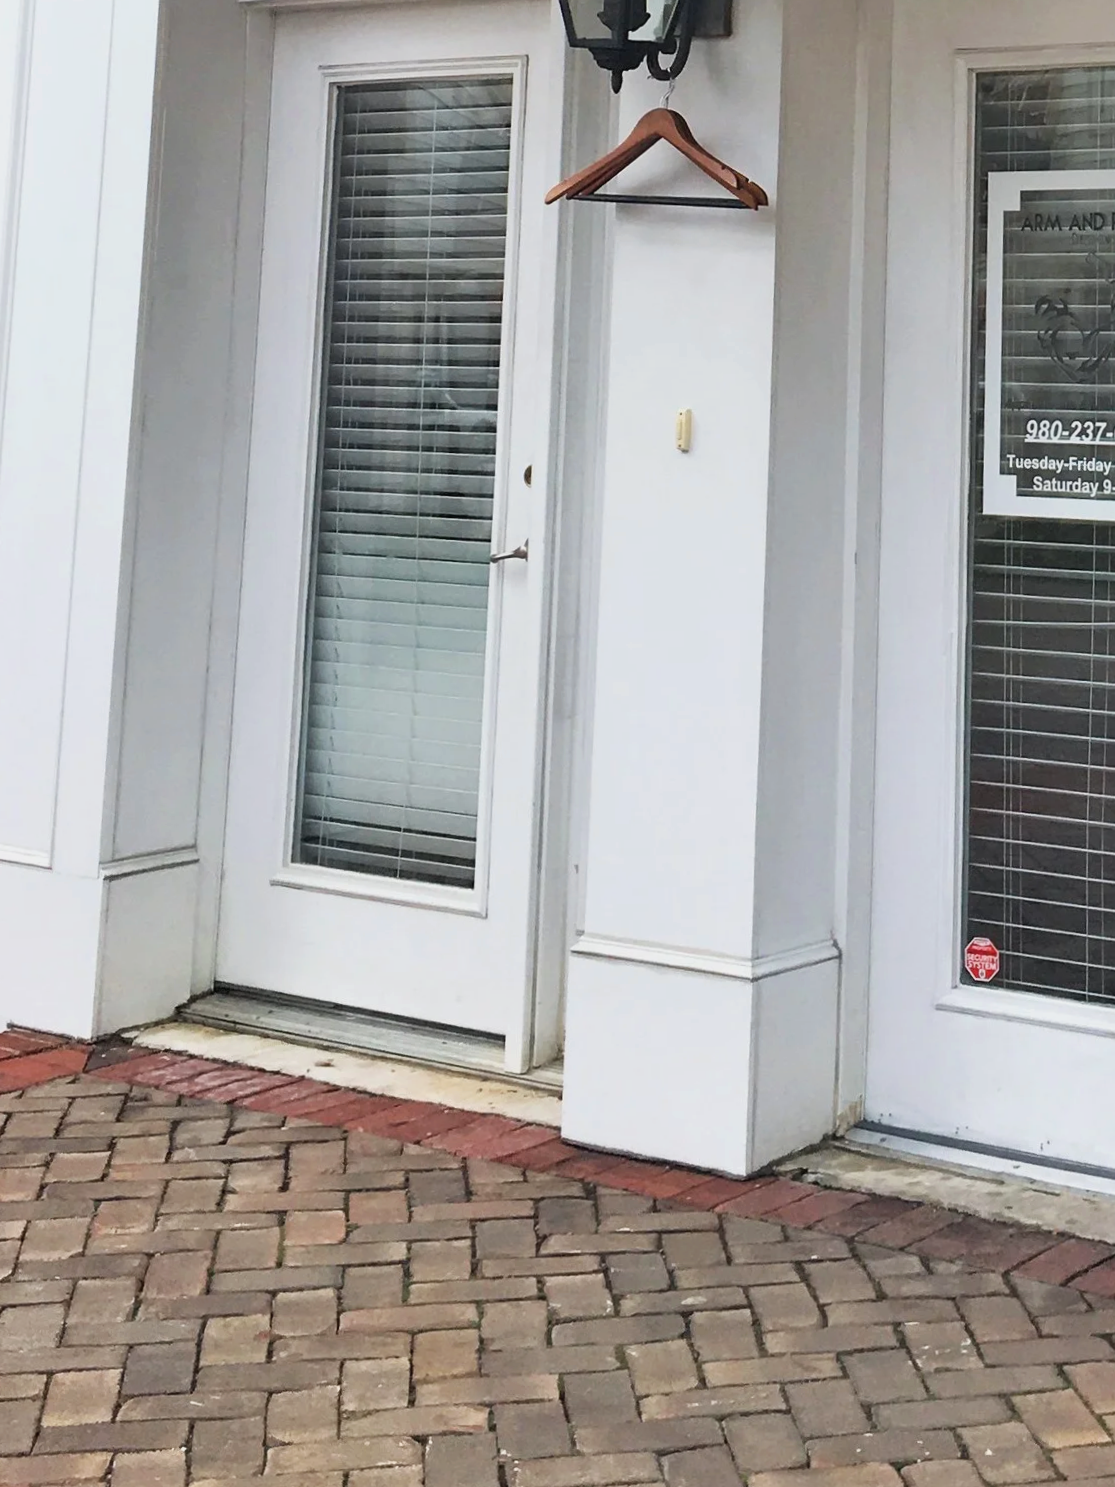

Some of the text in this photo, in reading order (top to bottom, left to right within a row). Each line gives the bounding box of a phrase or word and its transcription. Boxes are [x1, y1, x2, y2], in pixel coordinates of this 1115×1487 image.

[1021, 213, 1062, 232] ARM
[1069, 212, 1105, 231] AND
[1006, 454, 1111, 475] Tuesday-Friday
[1033, 476, 1099, 497] Saturday
[967, 953, 996, 963] SECURITY
[968, 961, 996, 970] SYSTEM
